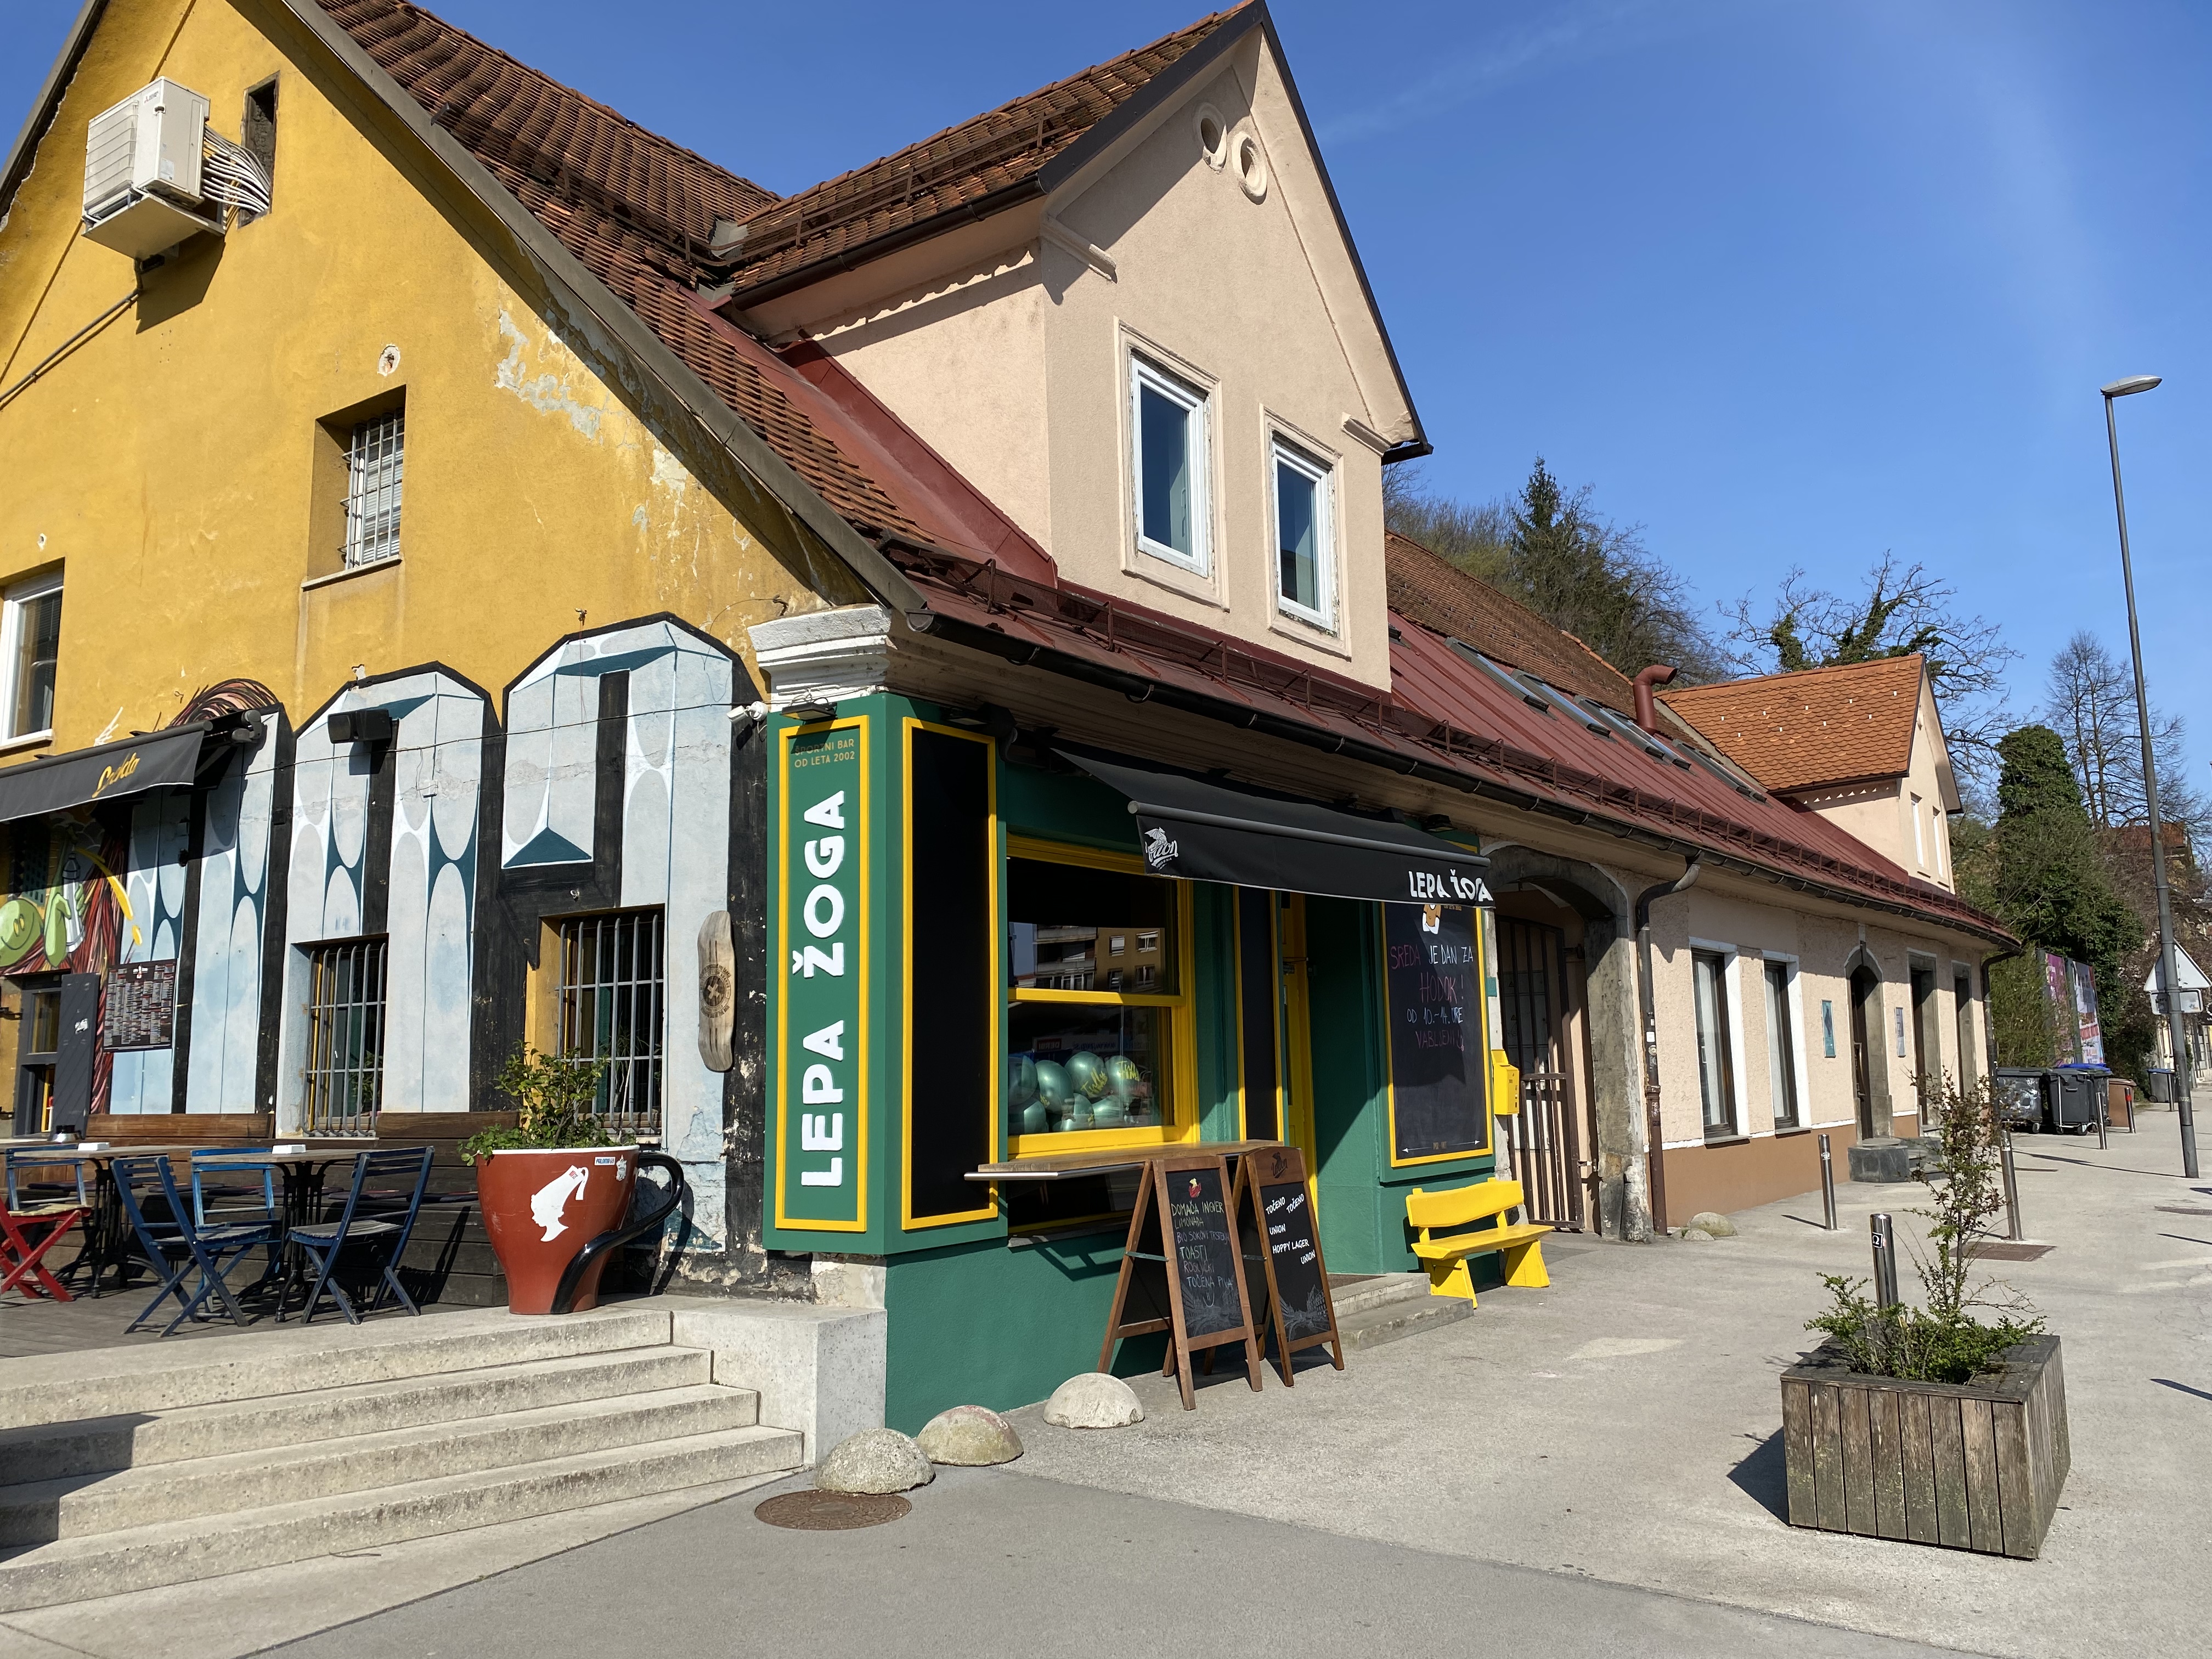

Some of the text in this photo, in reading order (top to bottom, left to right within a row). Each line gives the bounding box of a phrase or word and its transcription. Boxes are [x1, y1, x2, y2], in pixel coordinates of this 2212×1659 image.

[795, 738, 854, 756] ŠPORTNI BAR
[794, 751, 855, 768] OD LETA 2002
[1408, 871, 1451, 898] LEPA
[1390, 944, 1474, 969] SREDA JE DAN ZA
[792, 789, 845, 1187] LEPA ŽOGA
[1407, 1008, 1417, 1024] OD
[1171, 1200, 1200, 1216] DOMAČA
[1265, 1197, 1285, 1215] TOČENO
[1286, 1193, 1305, 1214] TOČENO
[1174, 1216, 1205, 1229] LIMONADA
[1269, 1223, 1286, 1235] UNION
[1177, 1232, 1188, 1244] BIO
[1188, 1230, 1209, 1242] SOKOVI
[1180, 1244, 1208, 1262] TOASTI
[1272, 1239, 1310, 1254] HOPPY LAGER
[1300, 1249, 1316, 1265] UNION
[1187, 1274, 1234, 1291] TOČENA PIVA
